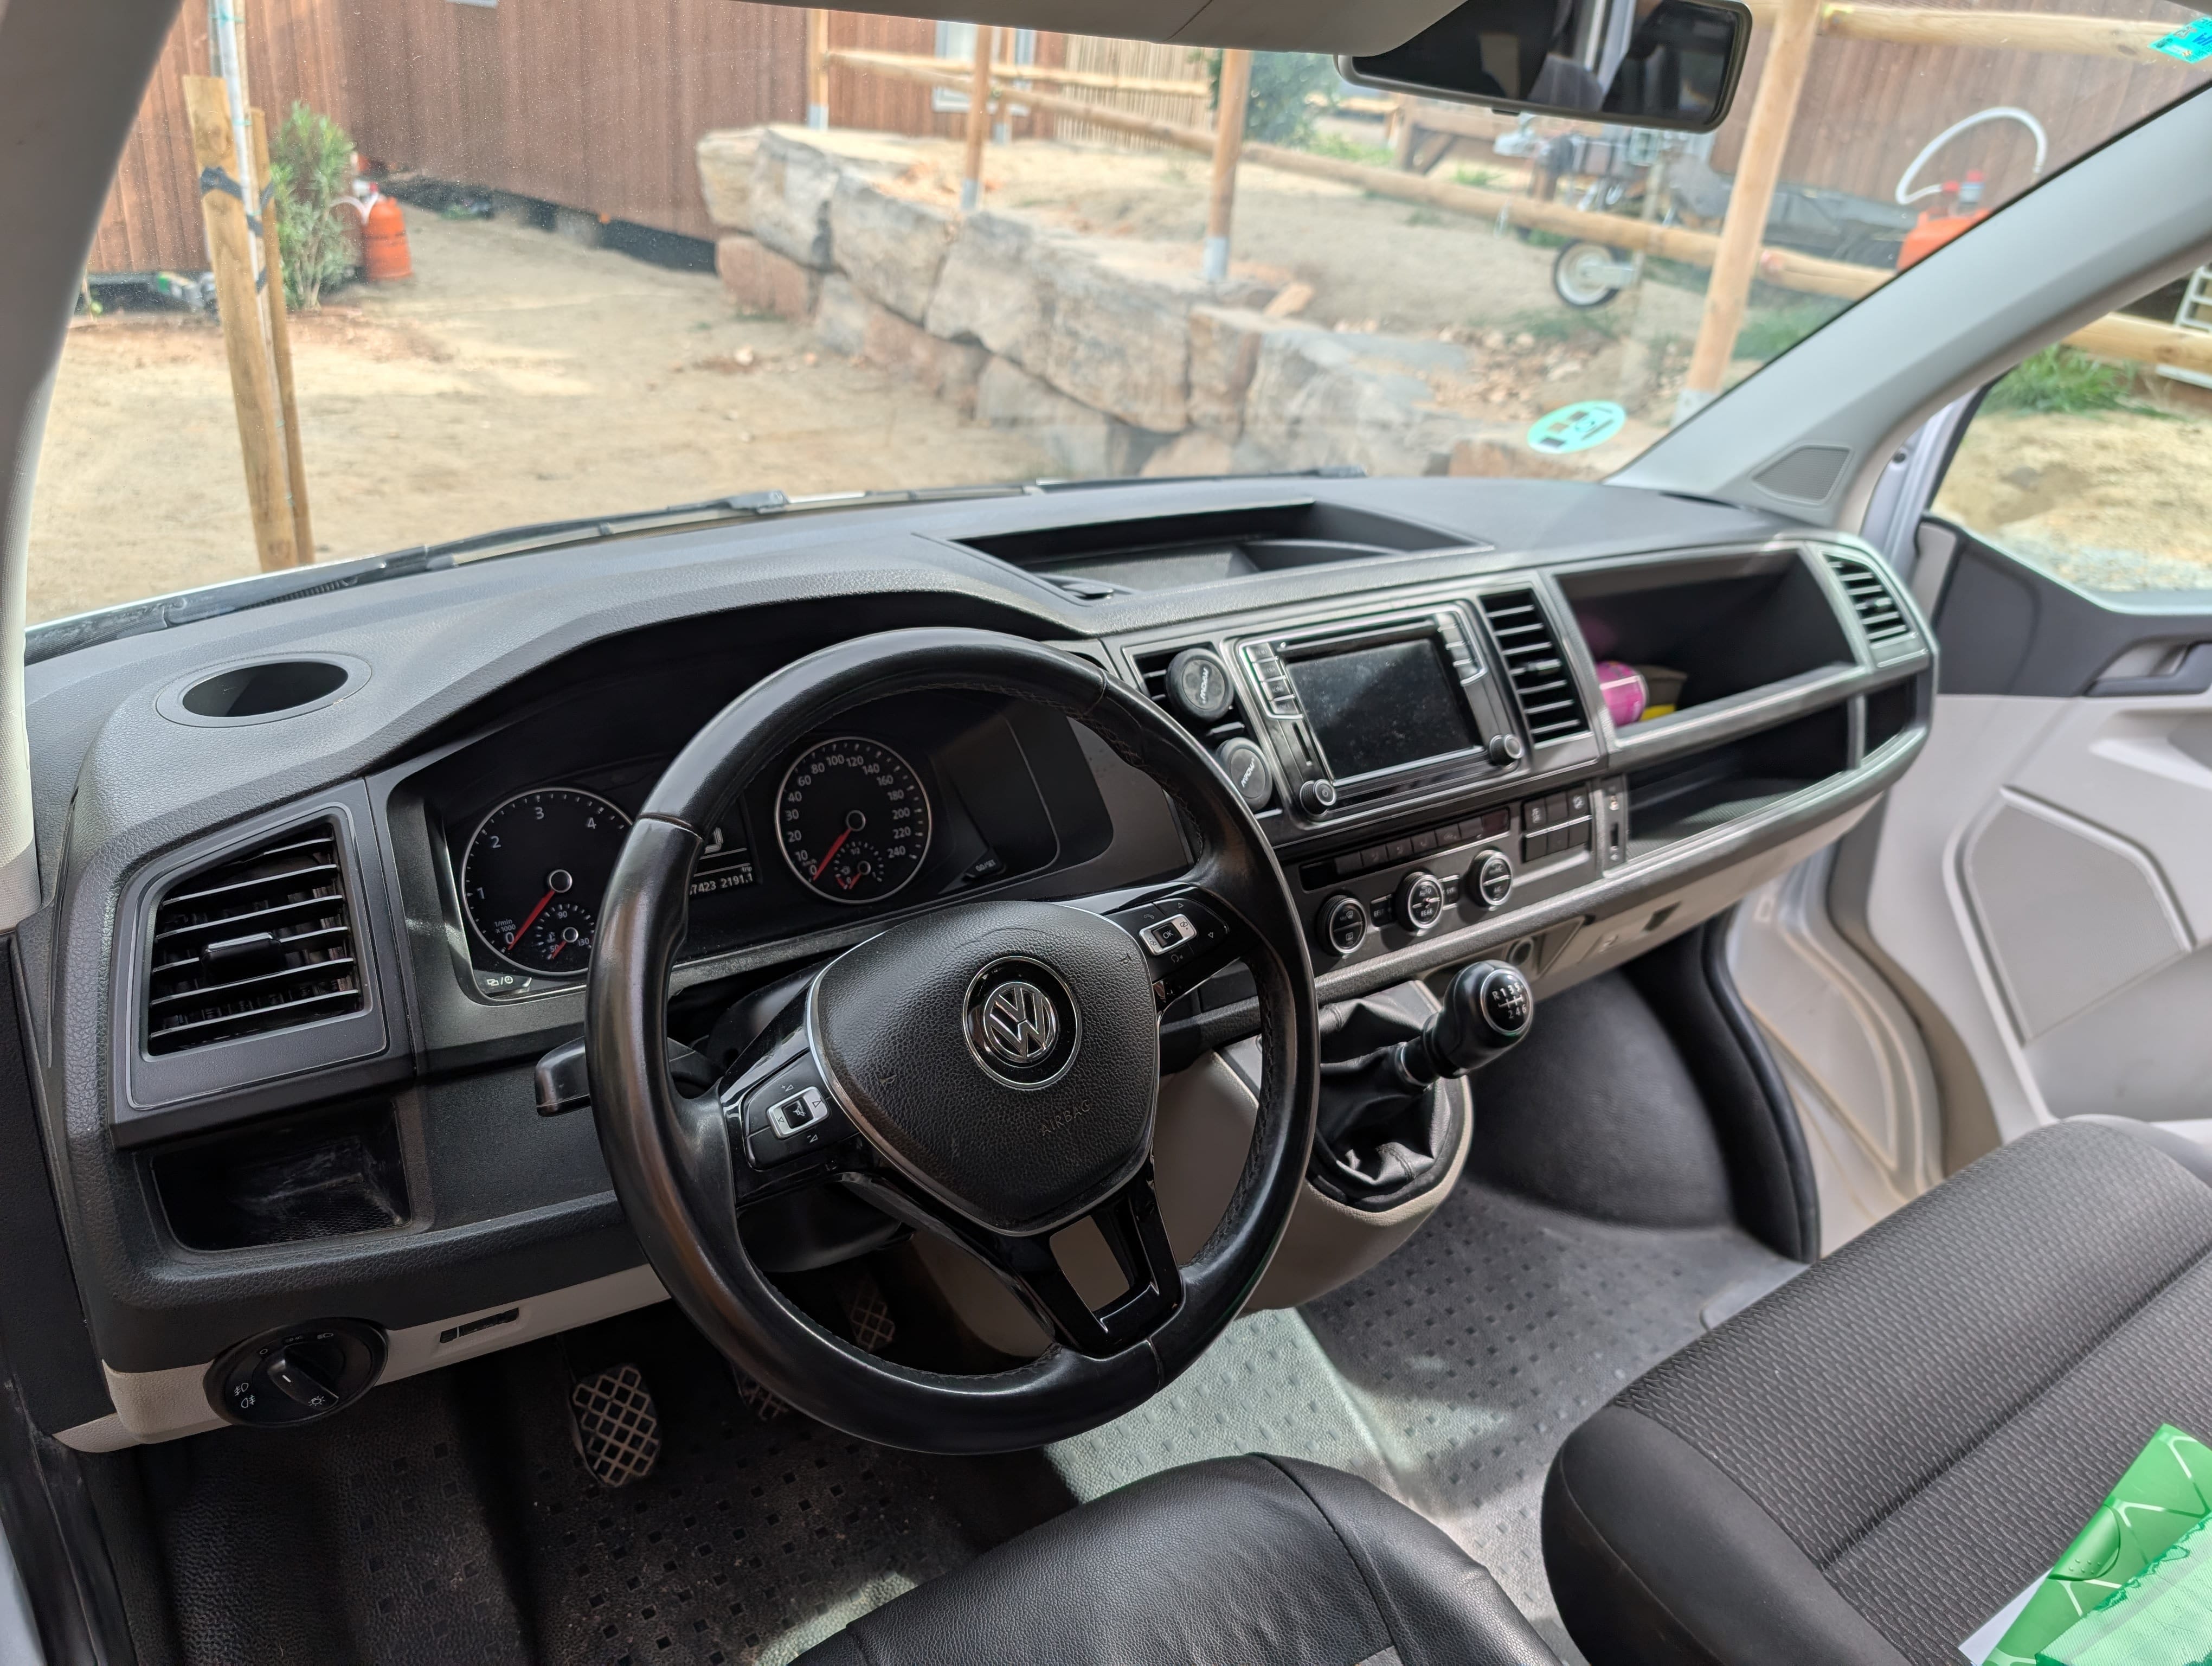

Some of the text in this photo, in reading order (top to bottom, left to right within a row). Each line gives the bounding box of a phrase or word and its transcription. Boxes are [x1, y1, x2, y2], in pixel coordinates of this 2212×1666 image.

[826, 754, 845, 767] 100
[846, 755, 864, 767] 120
[811, 762, 825, 774] 80
[862, 763, 880, 776] 140
[798, 774, 812, 786] 60
[876, 774, 894, 786] 160
[1240, 761, 1255, 788] MPOW
[788, 791, 802, 802] 40
[887, 789, 904, 801] 180
[535, 806, 544, 820] 3
[785, 809, 799, 821] 30
[892, 807, 910, 820] 200
[586, 817, 596, 829] 4
[787, 830, 802, 842] 20
[892, 826, 911, 840] 220
[490, 835, 501, 849] 2
[794, 849, 808, 862] 10
[887, 845, 906, 858] 240
[809, 864, 817, 876] 0
[689, 873, 753, 895] 7423 2191.1
[477, 887, 485, 900] 1
[558, 911, 568, 919] 90
[494, 919, 513, 927] 1/min
[501, 924, 516, 932] 1000
[505, 931, 515, 944] 0
[1162, 930, 1174, 939] OK
[577, 938, 590, 946] 130
[1491, 982, 1521, 1001] R 1 3 5
[1508, 1004, 1527, 1019] 2 4 6
[1041, 1099, 1091, 1137] AIRBAG
